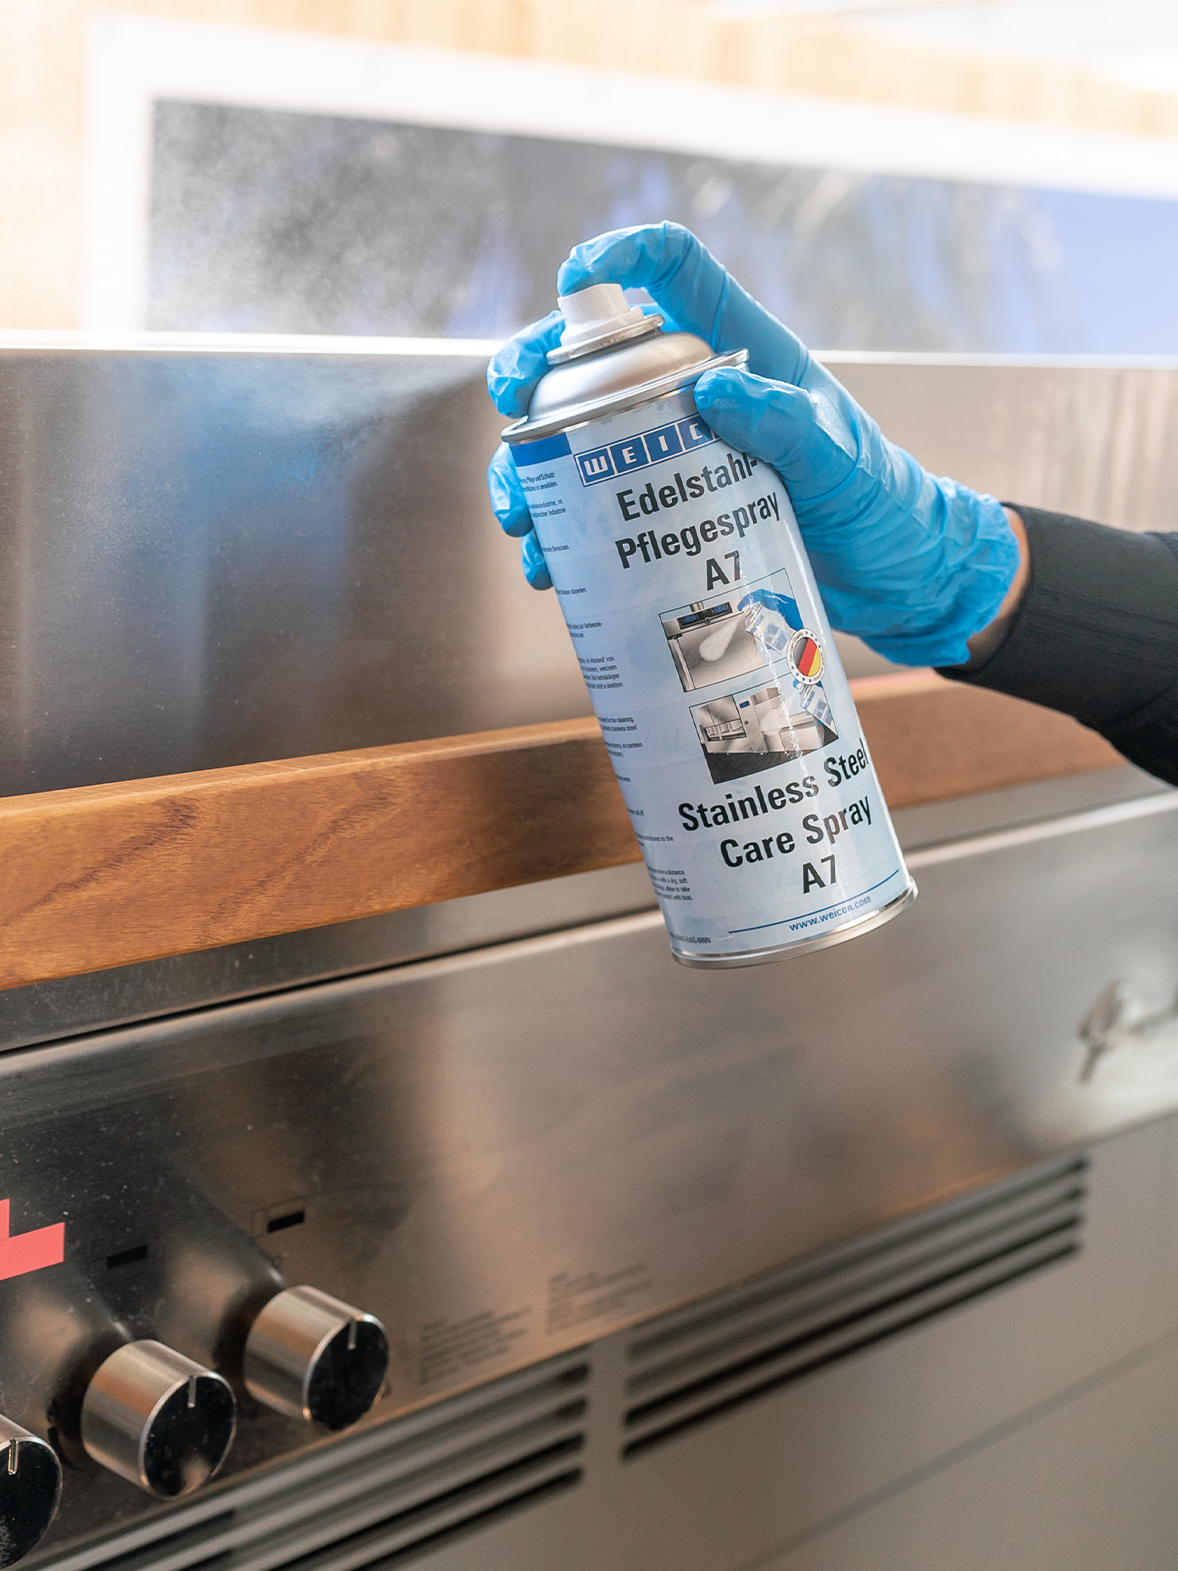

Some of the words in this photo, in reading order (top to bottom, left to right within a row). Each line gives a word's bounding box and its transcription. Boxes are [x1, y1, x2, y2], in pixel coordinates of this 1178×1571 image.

[583, 422, 704, 476] WEIC
[616, 452, 758, 522] Edelstahl-
[615, 491, 780, 569] Pflegespray
[706, 549, 741, 591] A7
[678, 775, 819, 831] Stainless
[823, 737, 869, 787] Steel
[720, 831, 795, 868] Care
[802, 795, 872, 845] Spray
[802, 854, 837, 894] A7
[788, 895, 872, 932] www.weicon.com
